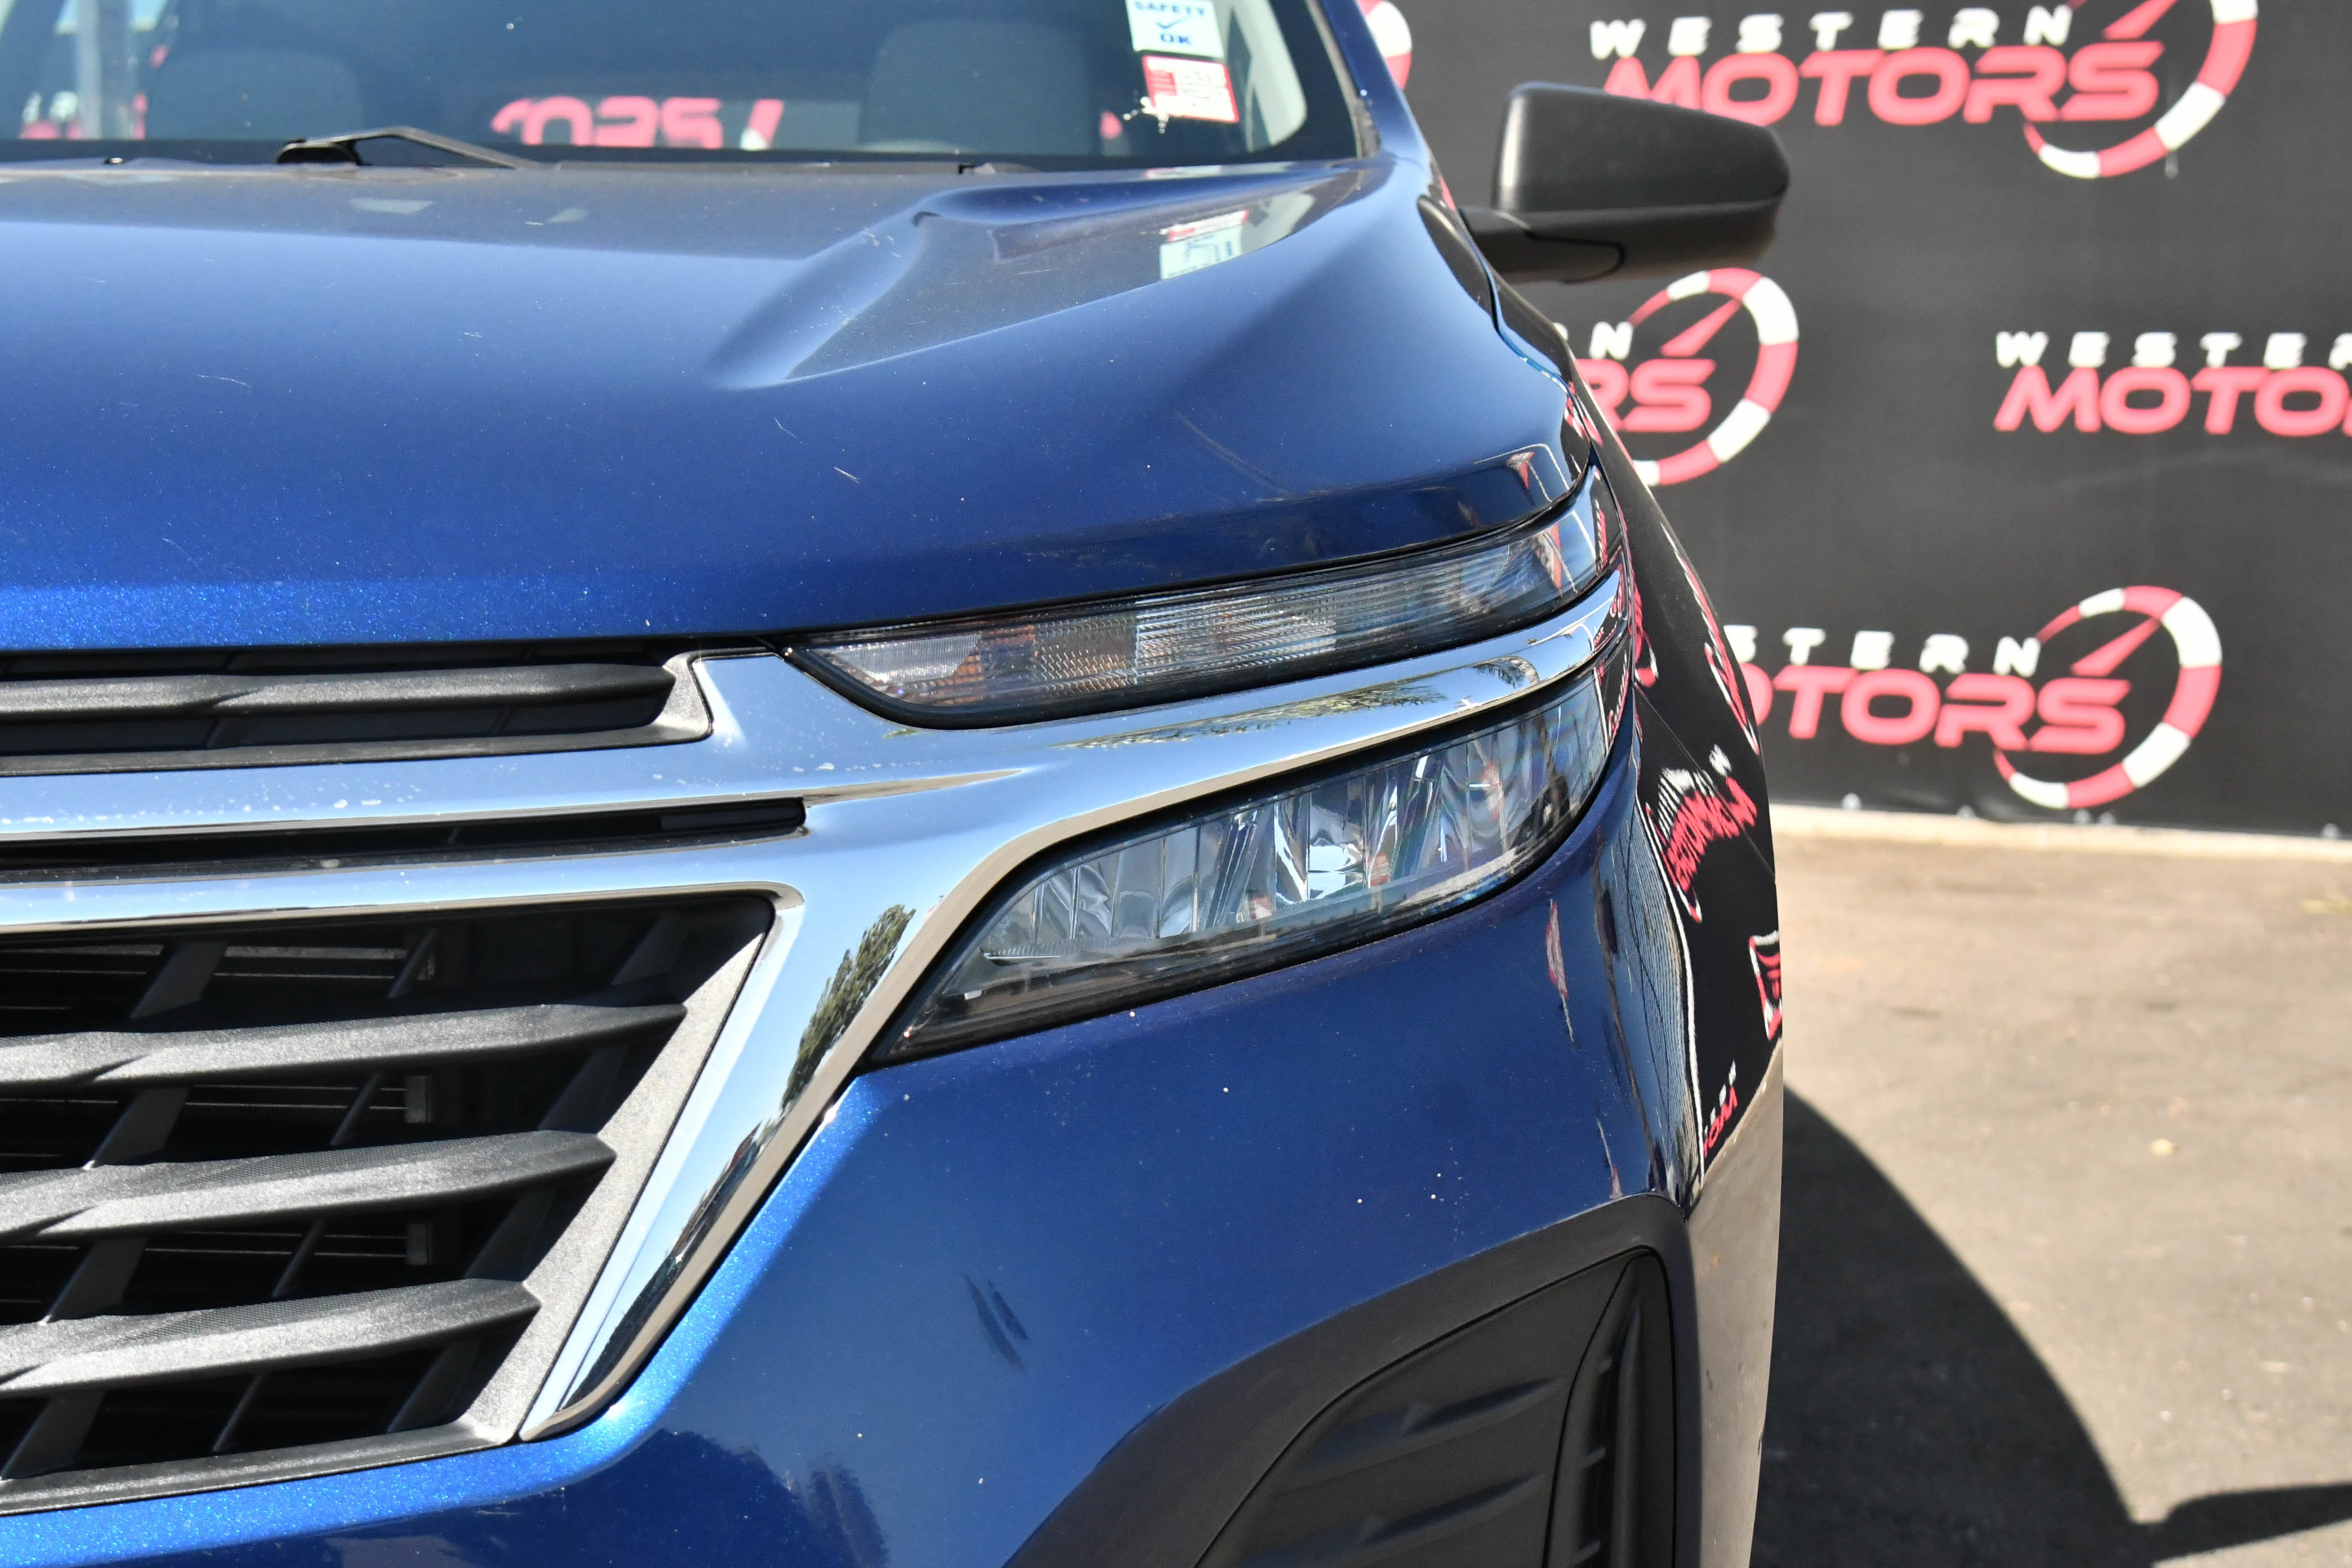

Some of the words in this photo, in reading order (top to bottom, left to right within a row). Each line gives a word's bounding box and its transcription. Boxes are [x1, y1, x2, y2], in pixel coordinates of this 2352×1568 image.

[1160, 33, 1191, 45] OK
[1589, 5, 2074, 59] WESTERN
[1603, 41, 2165, 126] MOTORS
[1993, 364, 2352, 437] MOTO
